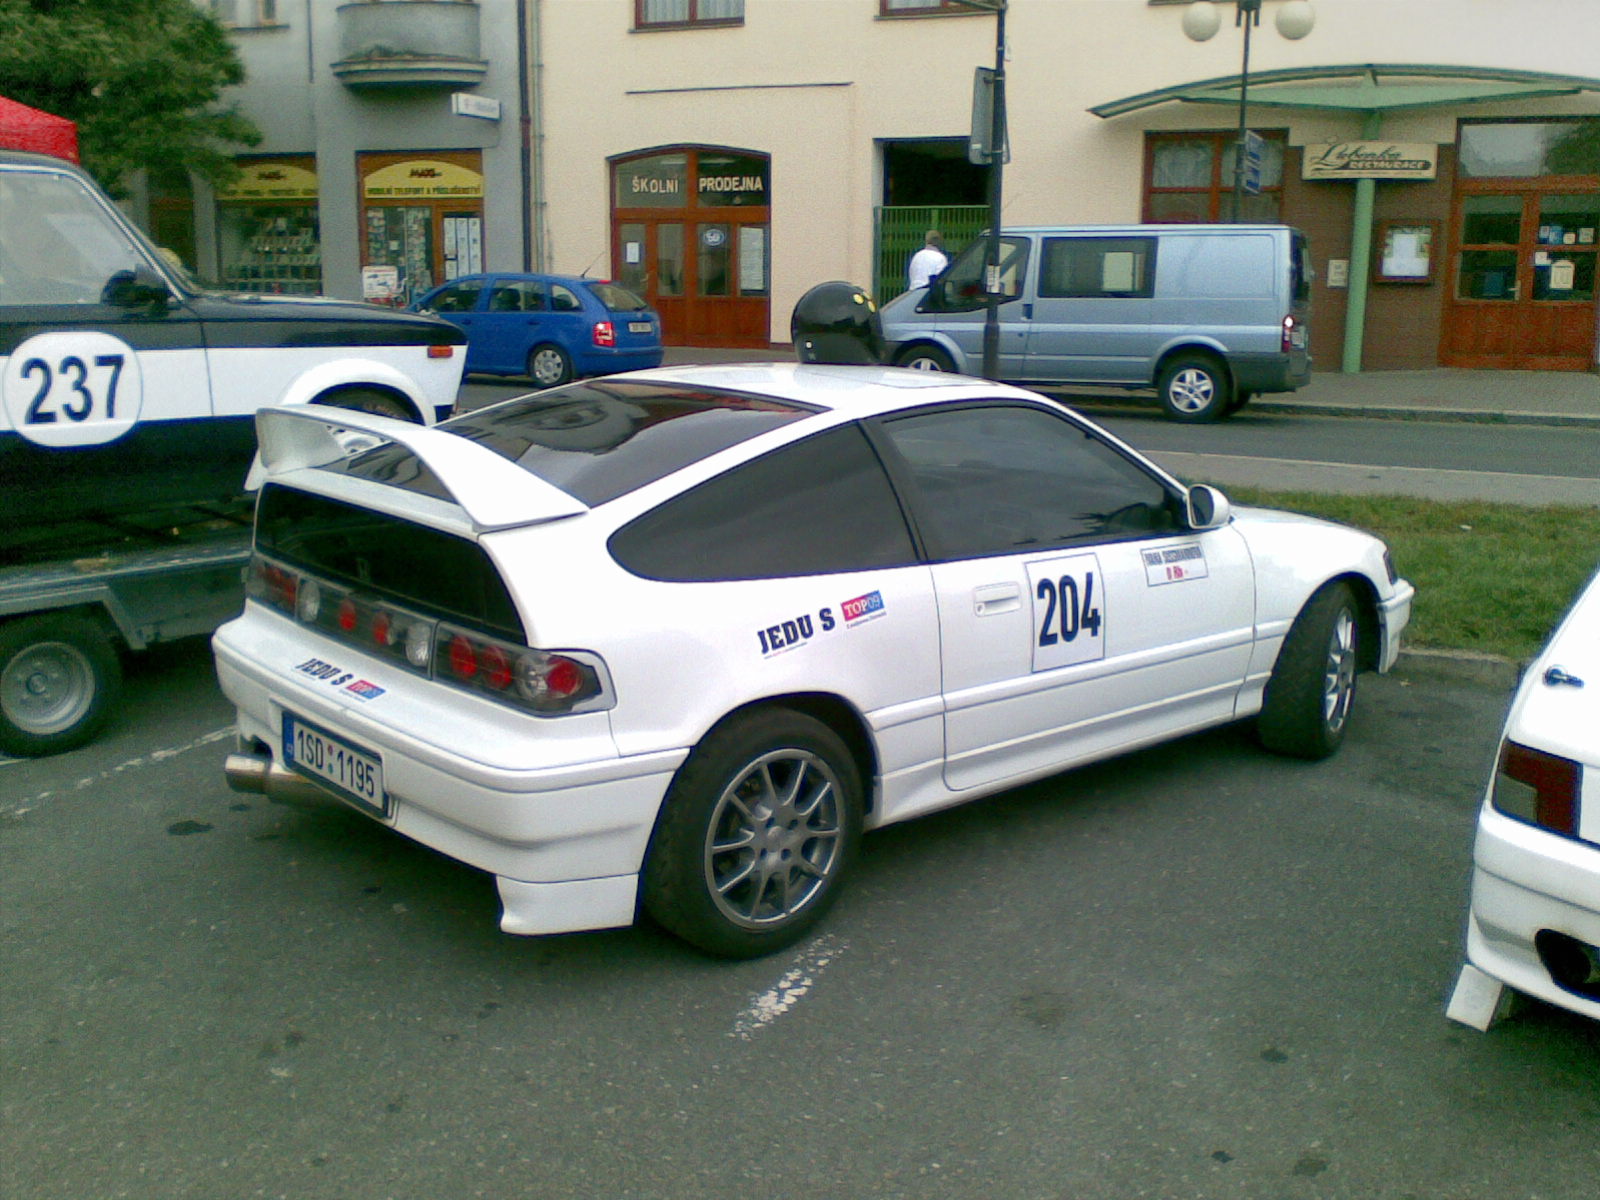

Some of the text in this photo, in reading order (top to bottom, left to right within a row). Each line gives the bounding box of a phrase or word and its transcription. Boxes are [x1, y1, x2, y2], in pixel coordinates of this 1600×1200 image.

[632, 176, 763, 193] ŠKOLNÍ PRODEJNA
[1349, 160, 1424, 169] RESTAURACE
[20, 354, 125, 424] 237
[757, 614, 814, 655] JEDU
[819, 607, 836, 632] S
[843, 594, 881, 618] TOP09
[1037, 571, 1101, 647] 204
[295, 658, 342, 680] JEDU
[330, 673, 354, 686] S
[297, 729, 375, 798] 1SD 1195
